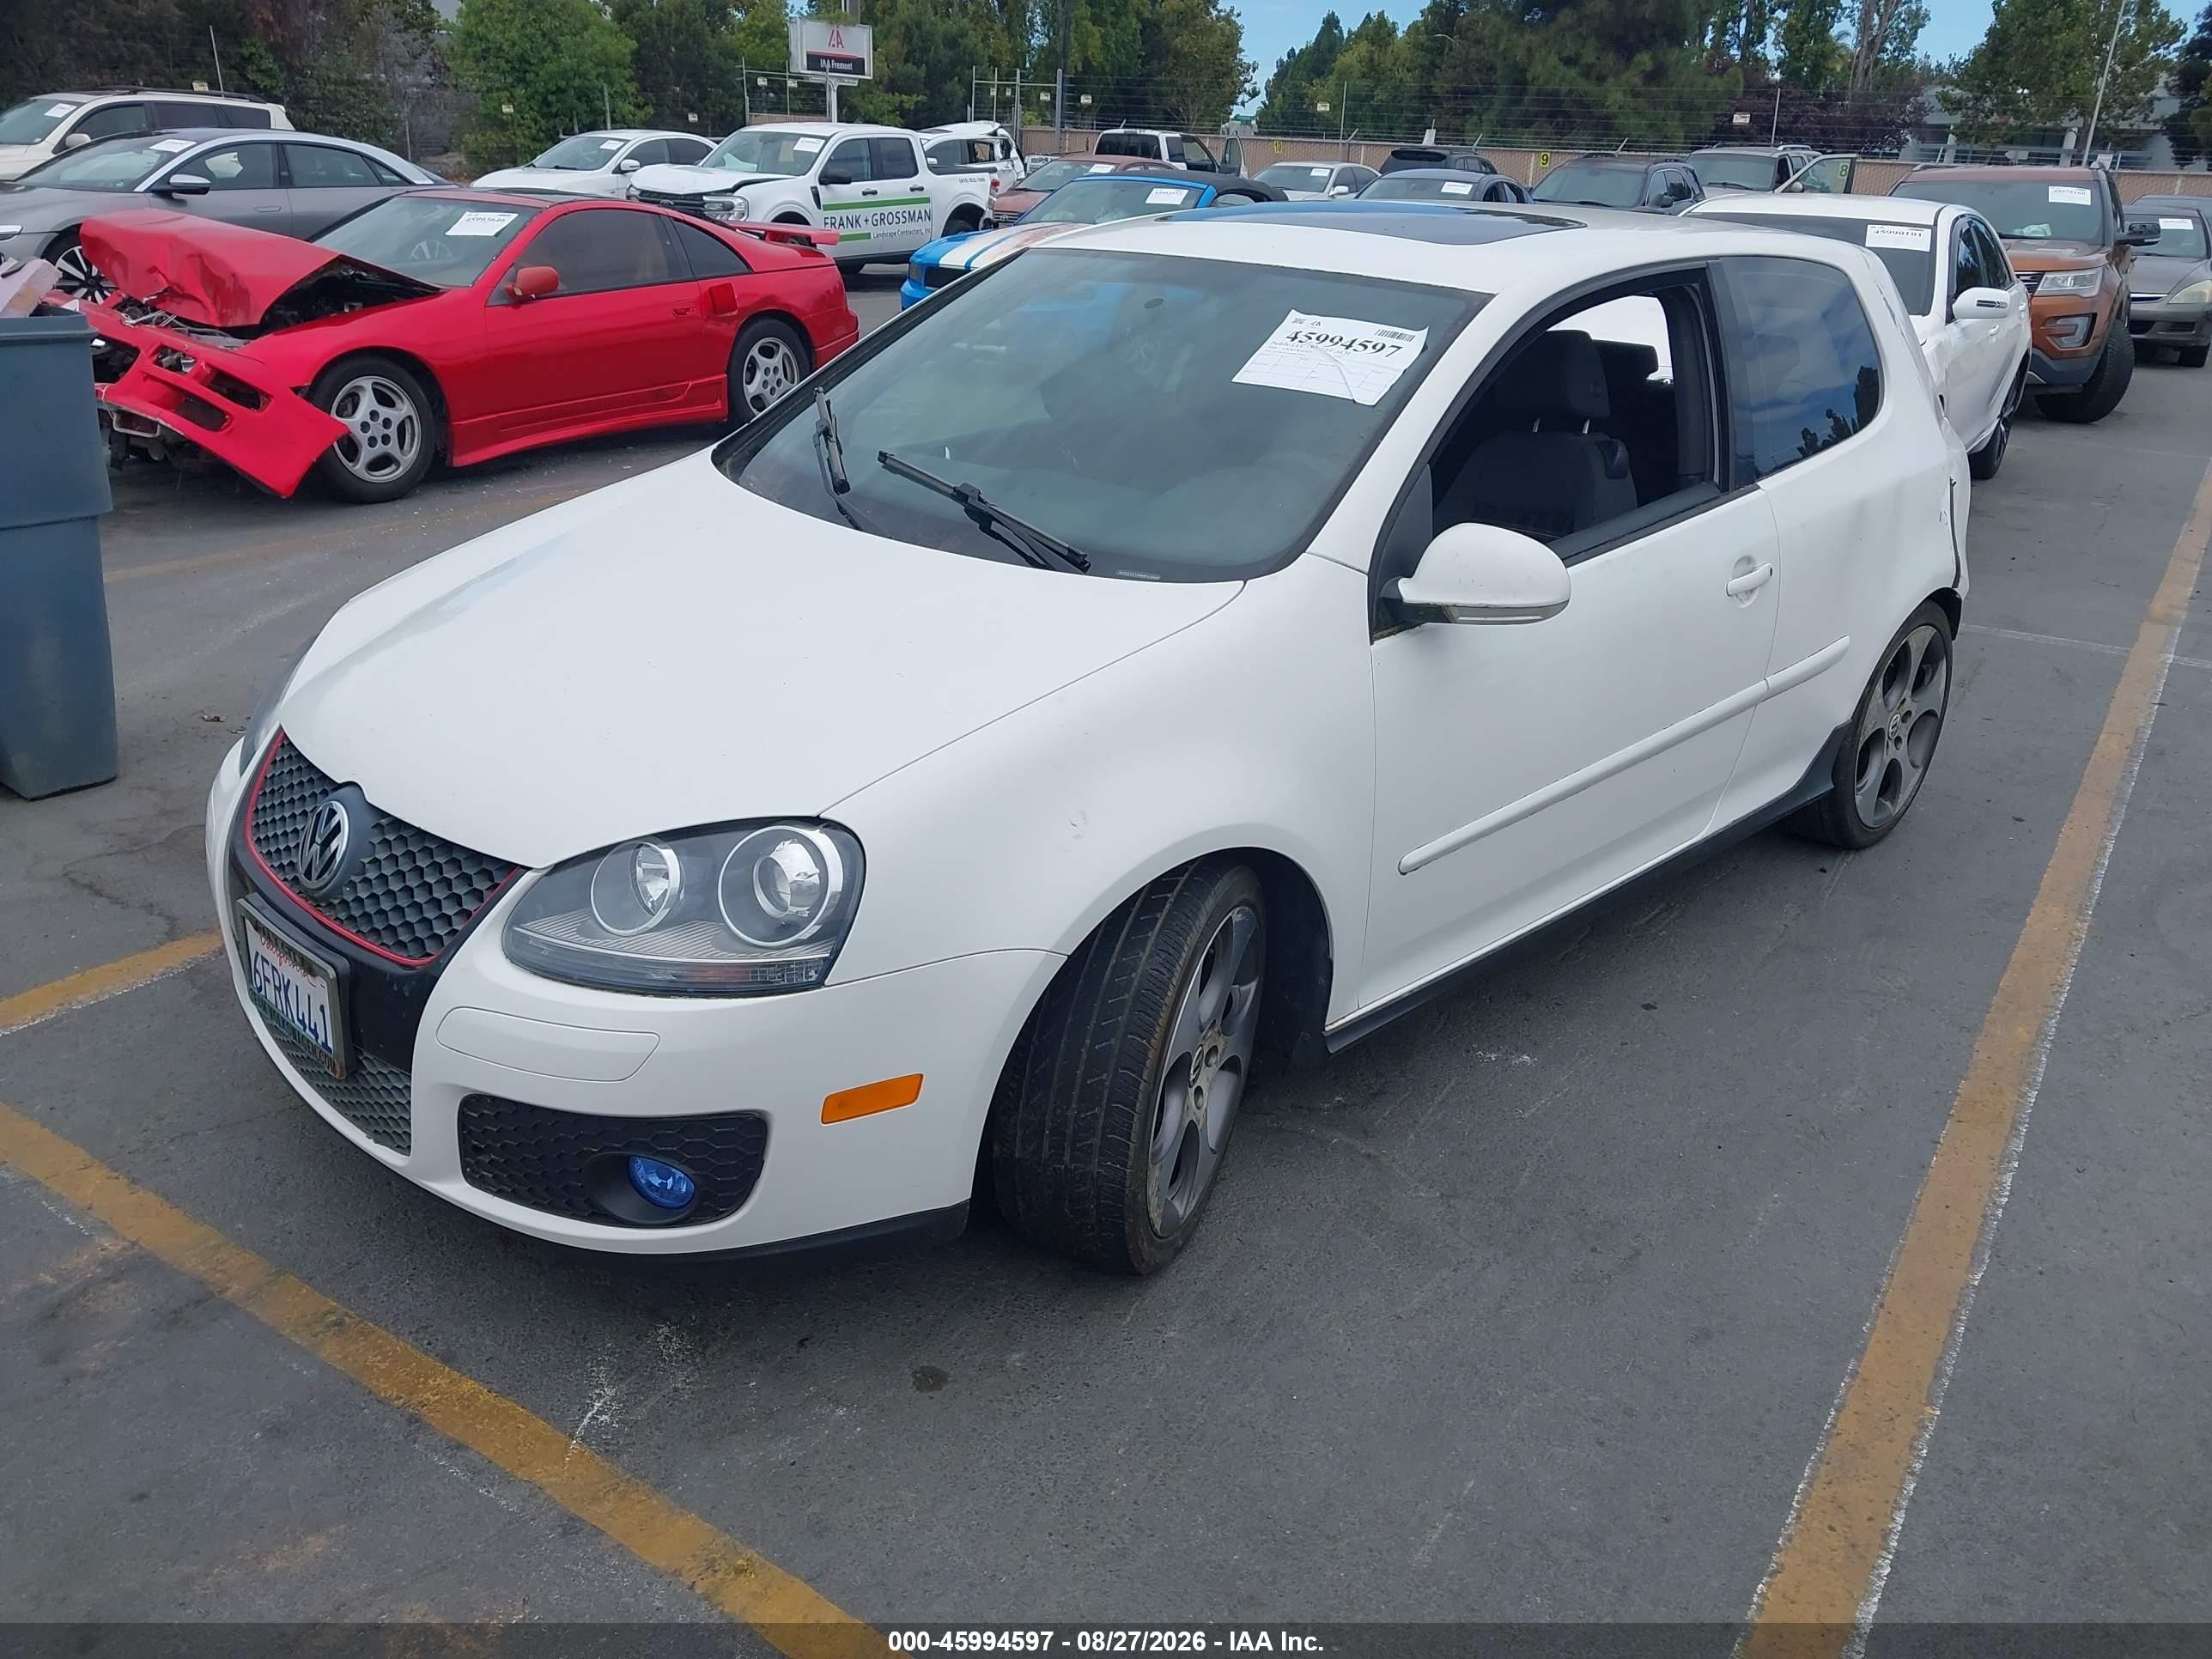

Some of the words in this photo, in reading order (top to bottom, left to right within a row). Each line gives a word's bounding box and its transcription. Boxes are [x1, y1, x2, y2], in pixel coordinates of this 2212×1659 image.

[831, 59, 853, 70] Fremont
[1541, 153, 1549, 166] 9
[1839, 164, 1849, 177] 8
[823, 214, 862, 229] FRANK
[871, 209, 931, 227] GROSSMAN
[872, 230, 896, 240] Landscape
[1285, 330, 1404, 358] 45994597
[253, 950, 333, 1055] 6FRK441
